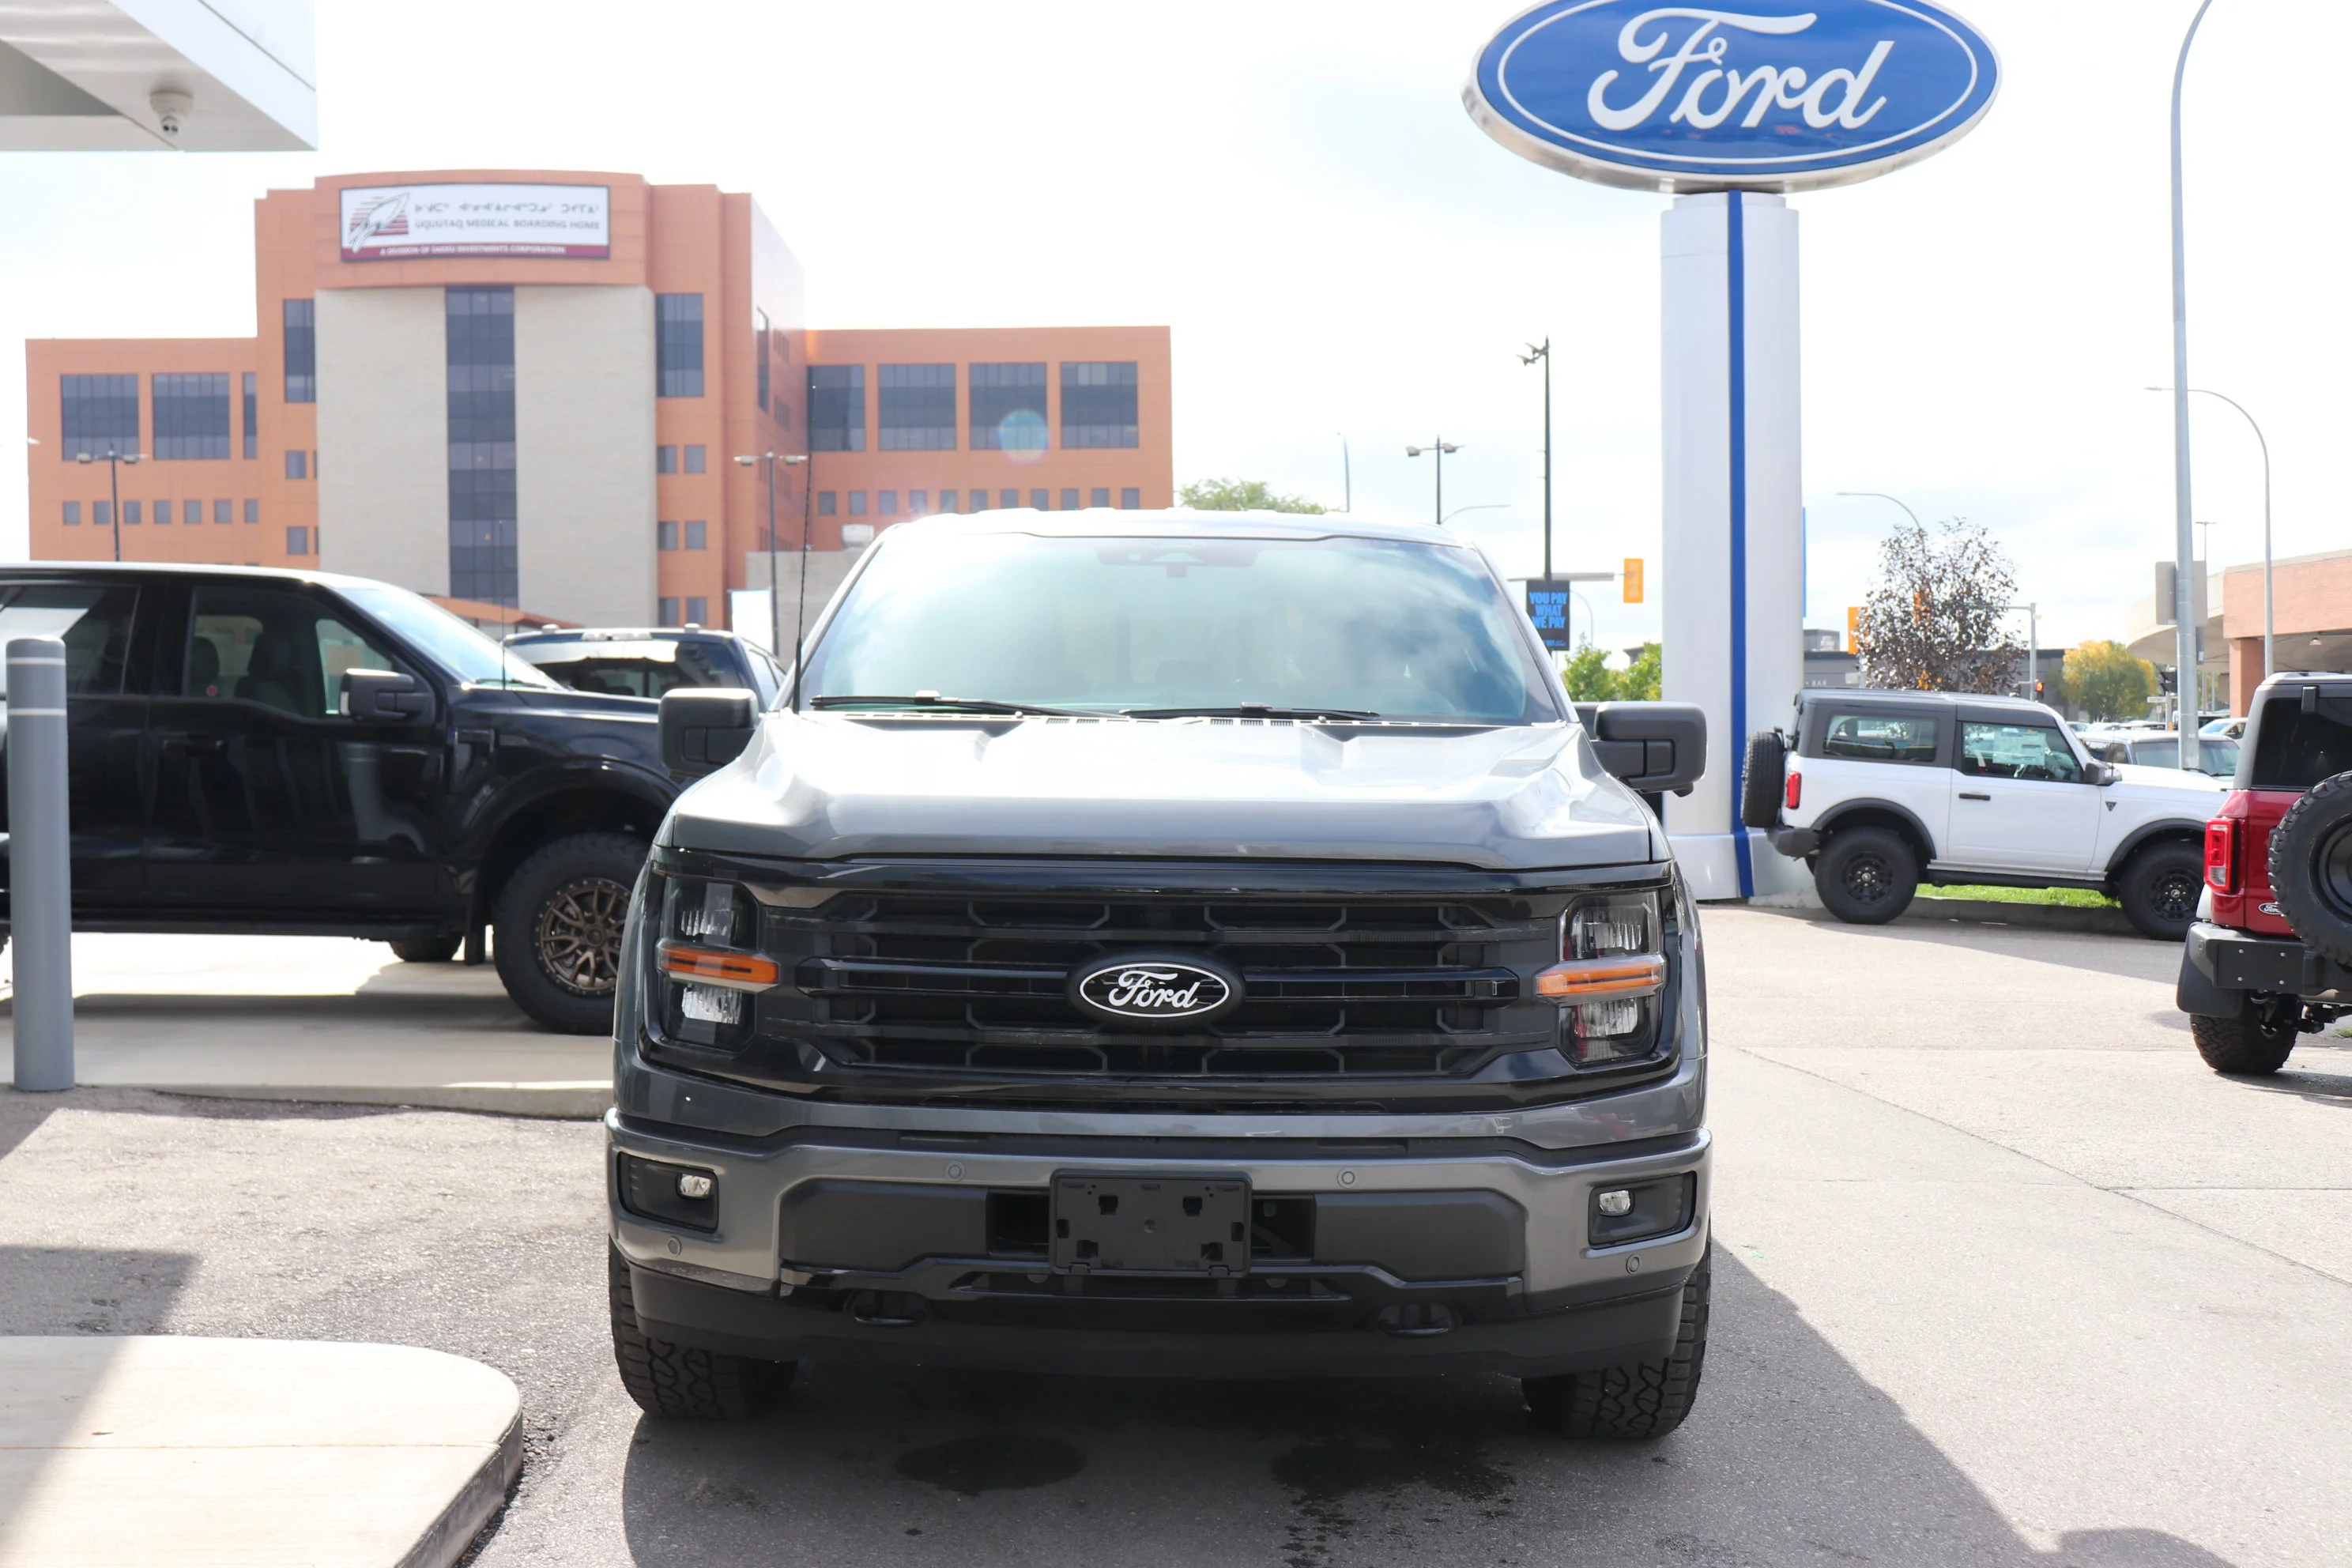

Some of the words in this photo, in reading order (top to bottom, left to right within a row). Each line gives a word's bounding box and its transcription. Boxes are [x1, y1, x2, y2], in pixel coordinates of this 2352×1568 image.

[1587, 7, 1895, 130] Ford
[466, 218, 509, 228] MEDICAL
[513, 218, 567, 228] BOARDING
[569, 220, 601, 230] HOME
[1528, 591, 1549, 605] YOU
[1550, 591, 1568, 605] PAY
[1535, 604, 1563, 616] WHAT
[1549, 616, 1566, 628] PAY
[1108, 970, 1200, 1008] Ford
